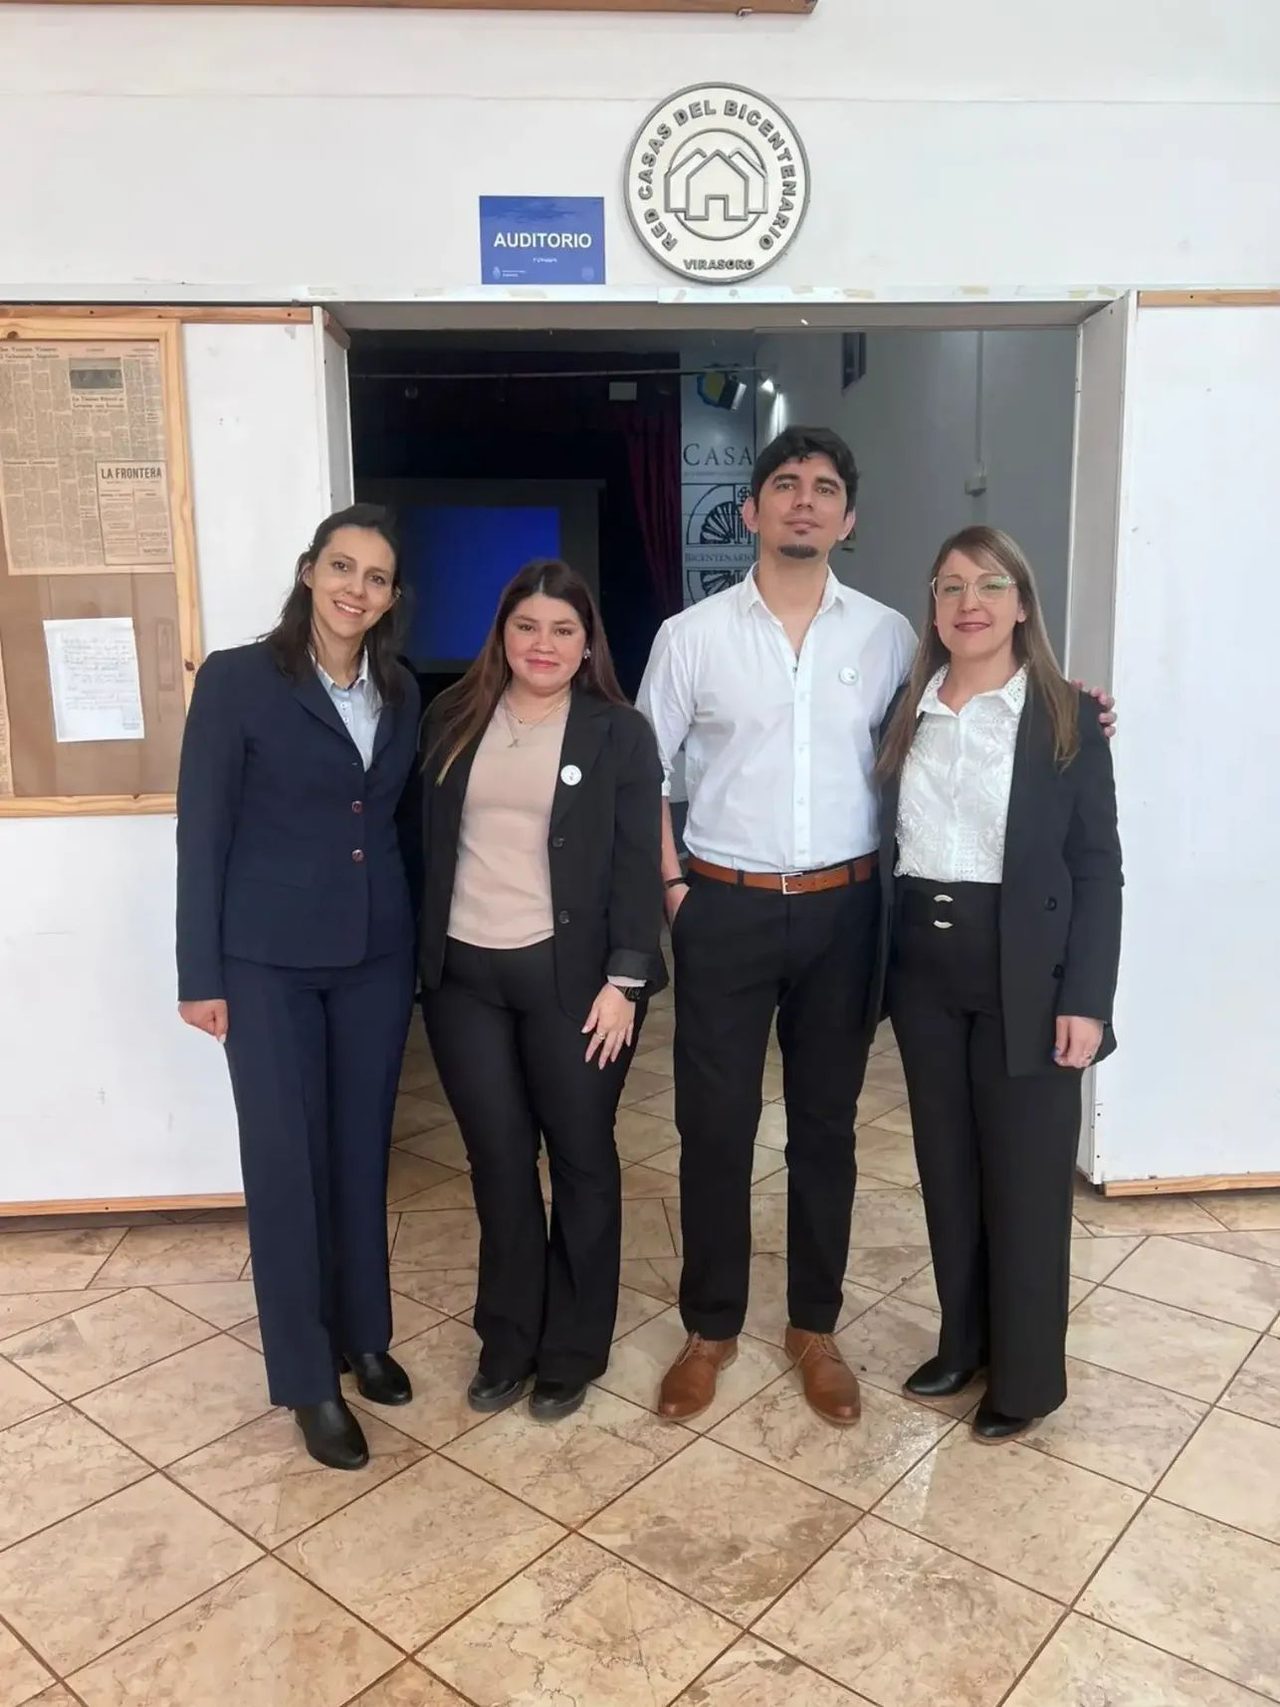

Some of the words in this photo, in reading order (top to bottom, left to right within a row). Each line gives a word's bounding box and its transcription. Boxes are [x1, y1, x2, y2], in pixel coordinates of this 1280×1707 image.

[673, 99, 717, 127] DEL
[637, 123, 673, 200] CASAS
[723, 99, 797, 250] BICENTENARIO
[493, 232, 593, 248] AUDITORIO
[643, 208, 678, 251] RED
[683, 258, 755, 271] VIRASORO
[683, 442, 753, 467] CASA
[101, 468, 113, 480] LA
[115, 466, 162, 480] FRONTERA
